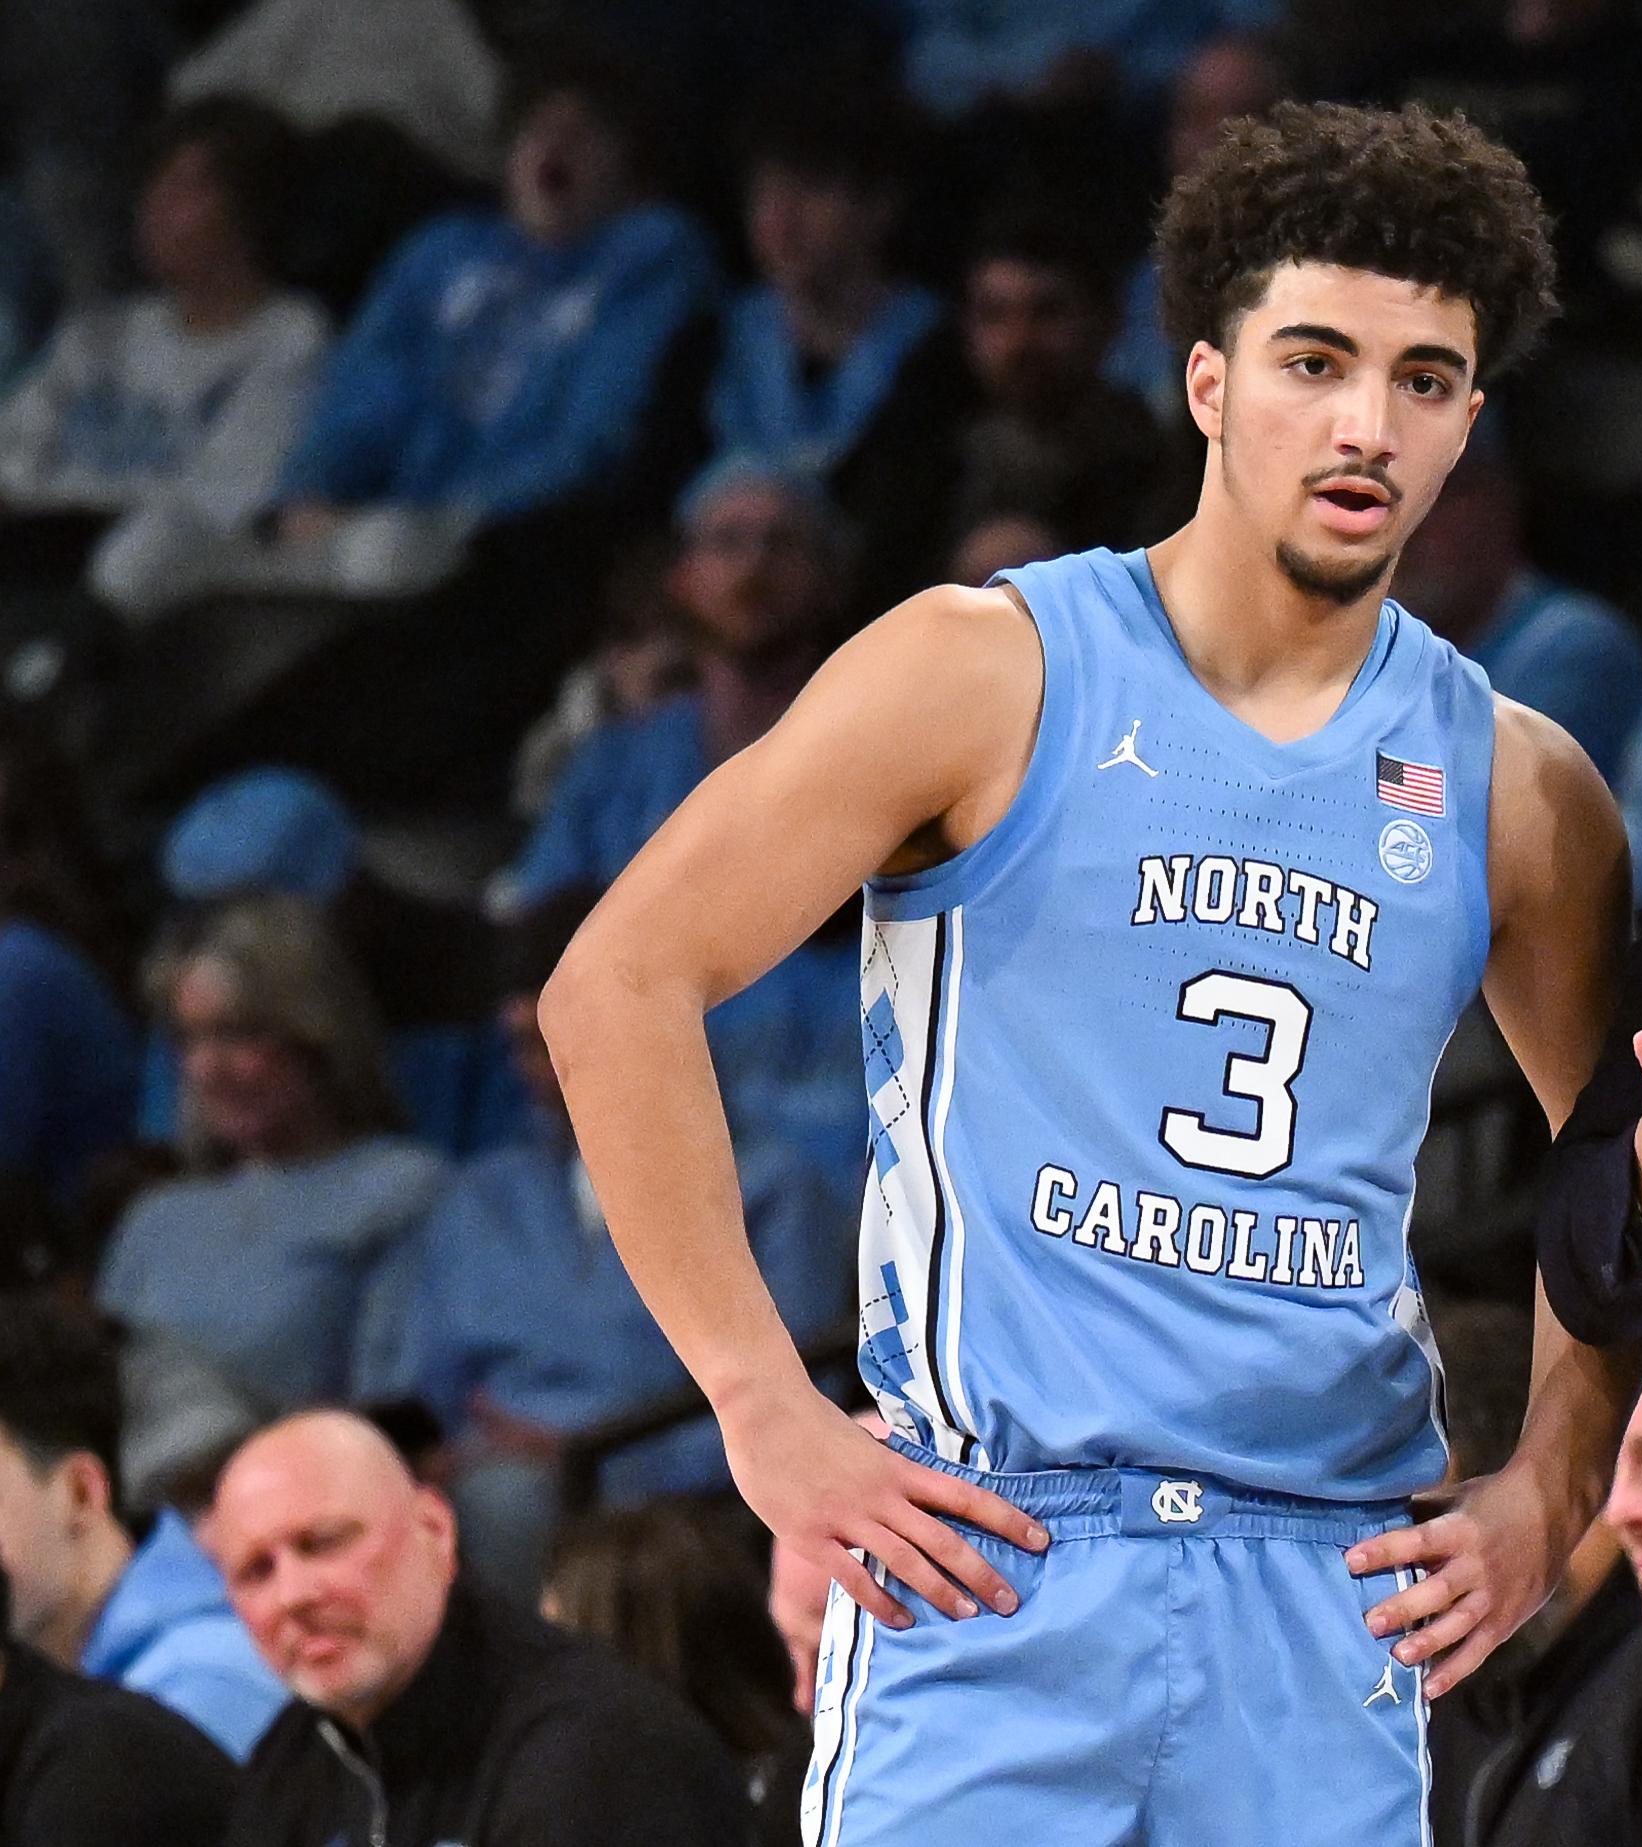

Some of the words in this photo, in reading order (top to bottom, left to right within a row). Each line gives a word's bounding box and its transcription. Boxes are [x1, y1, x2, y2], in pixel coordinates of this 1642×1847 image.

[1131, 855, 1379, 973] NORTH
[1158, 968, 1314, 1180] 3
[1030, 1162, 1365, 1288] CAROLINA
